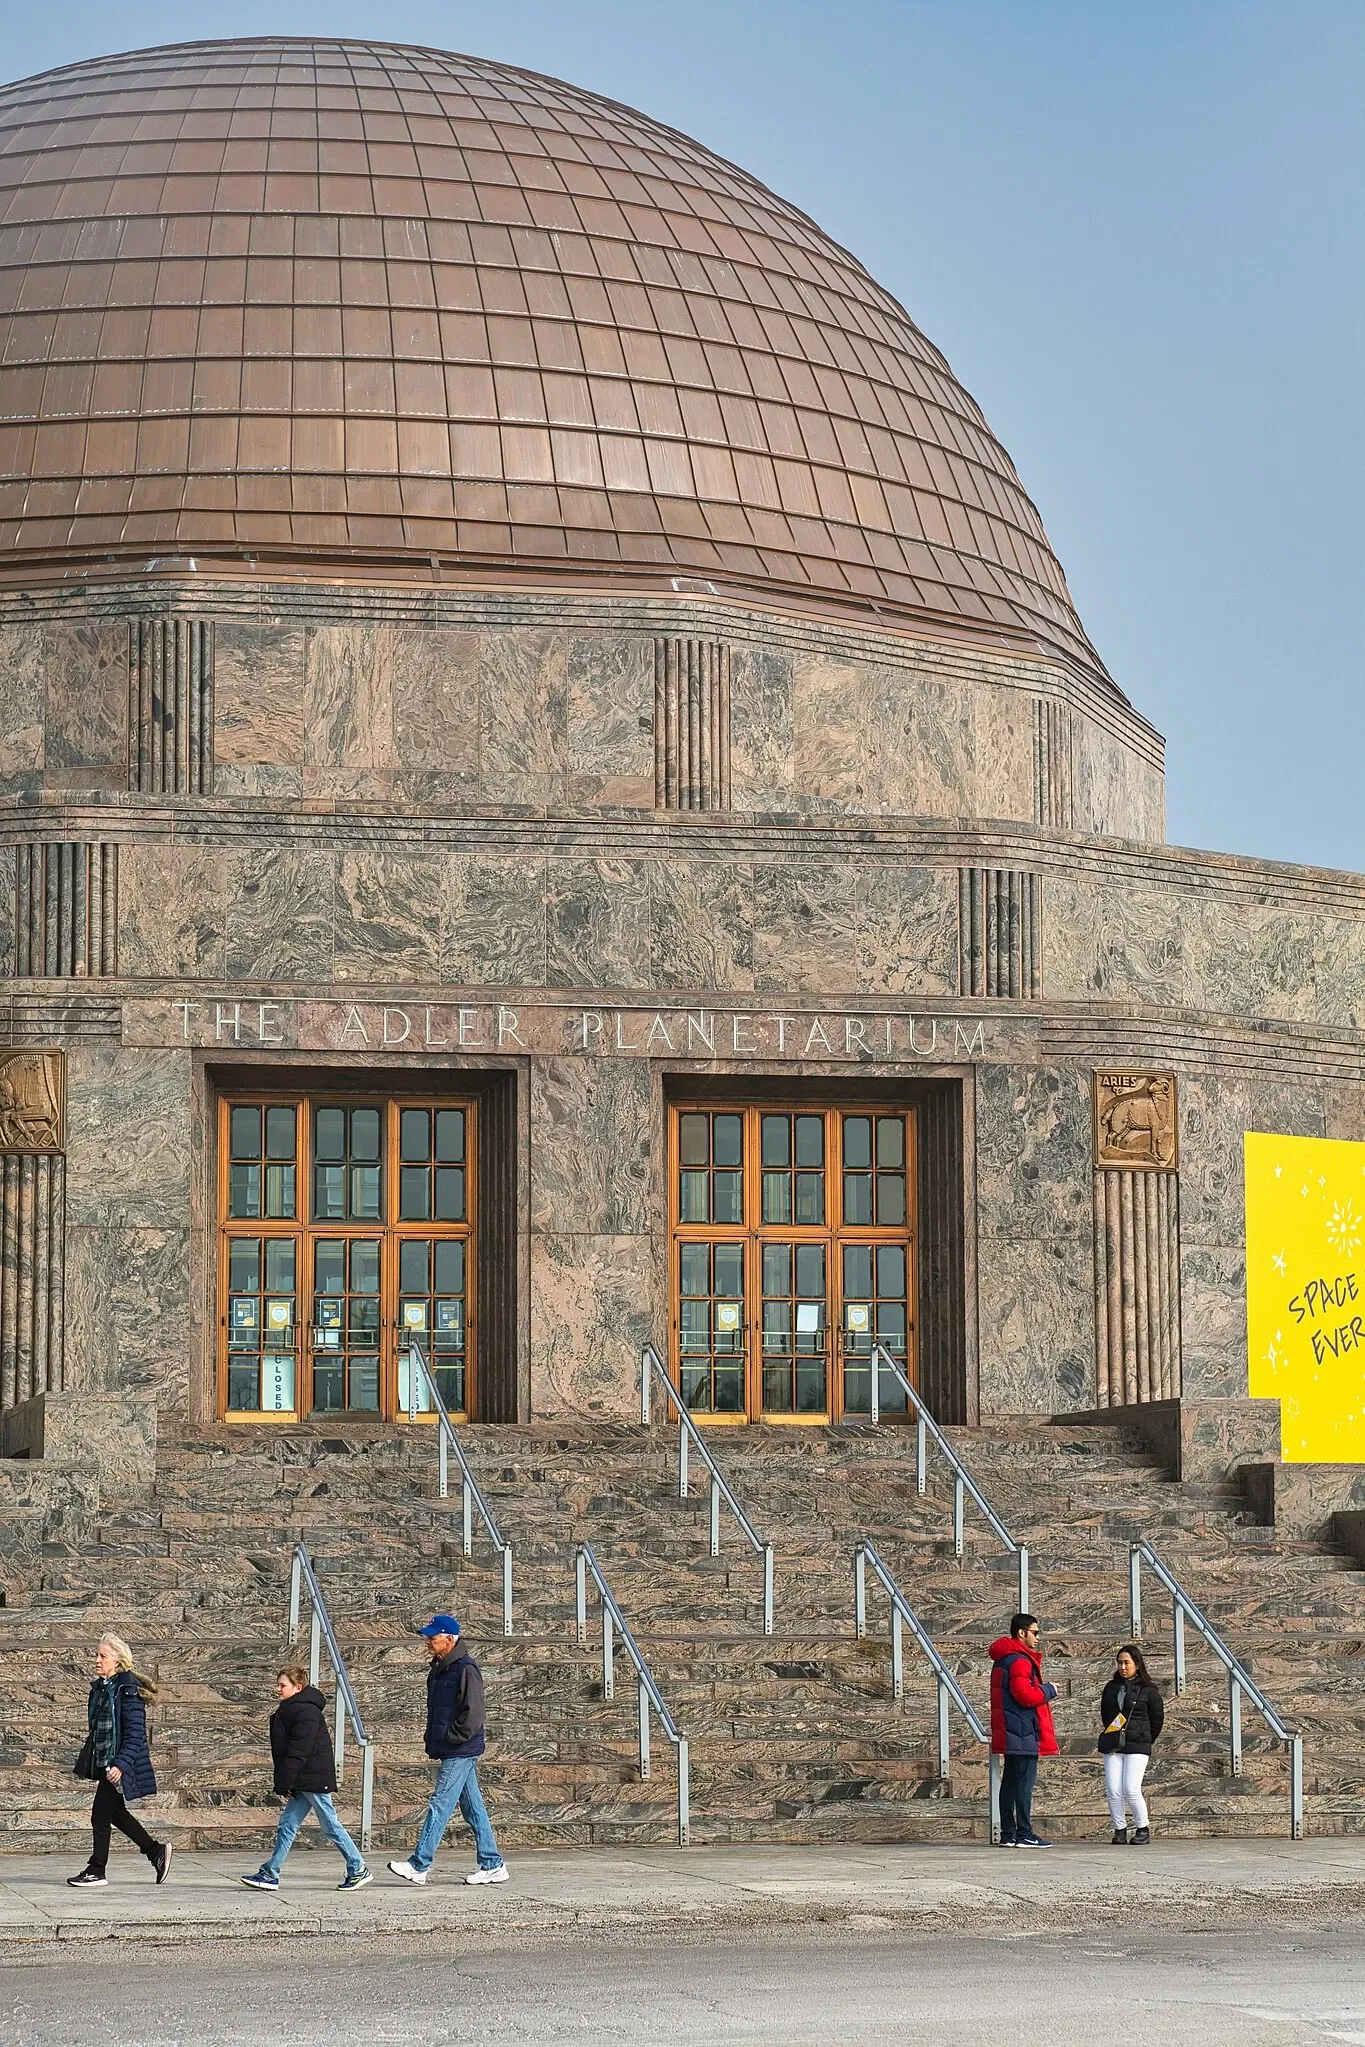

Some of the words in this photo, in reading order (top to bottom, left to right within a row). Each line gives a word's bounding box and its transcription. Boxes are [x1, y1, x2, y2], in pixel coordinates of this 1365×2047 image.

[172, 1001, 284, 1042] THE
[340, 1005, 526, 1047] ADLER
[582, 1011, 987, 1056] PLANETARIUM
[1101, 1075, 1137, 1088] ARIES
[1288, 1273, 1359, 1324] SPACE
[1311, 1316, 1365, 1365] EVER
[274, 1354, 282, 1410] CLOSED
